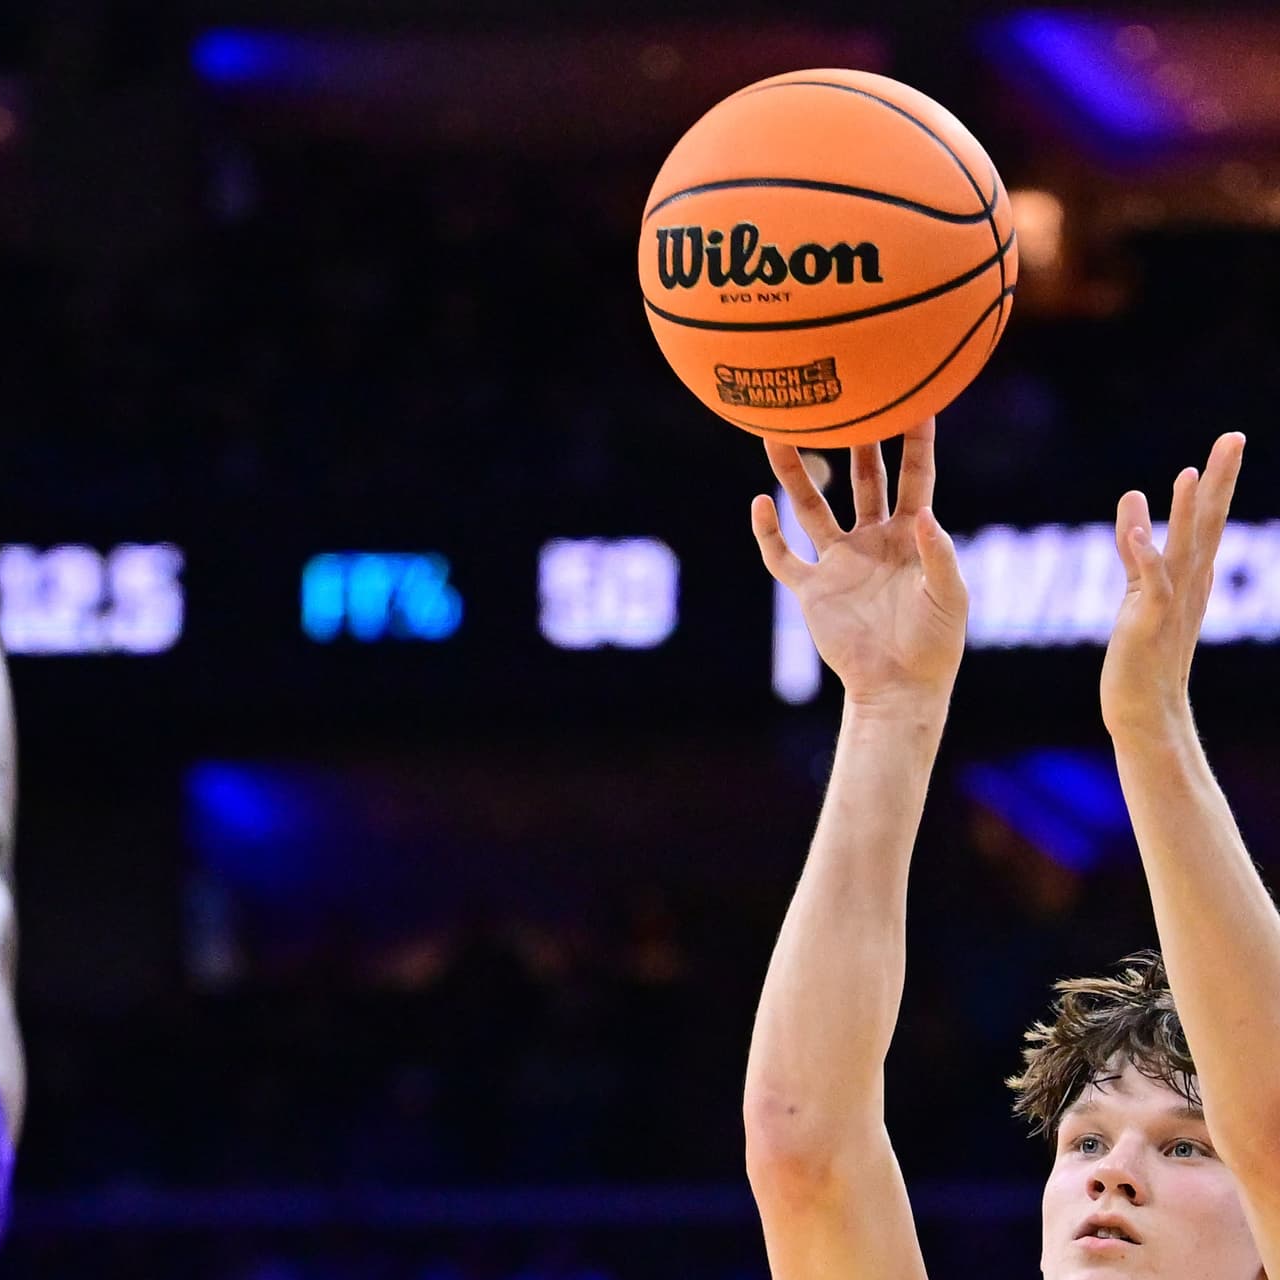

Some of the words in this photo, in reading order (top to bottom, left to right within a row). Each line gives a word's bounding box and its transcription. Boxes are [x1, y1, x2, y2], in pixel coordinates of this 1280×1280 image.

[656, 221, 884, 290] Wilson
[720, 292, 752, 303] EVO
[757, 291, 791, 303] NXT
[734, 368, 801, 387] MARCH
[748, 381, 839, 404] MADNESS
